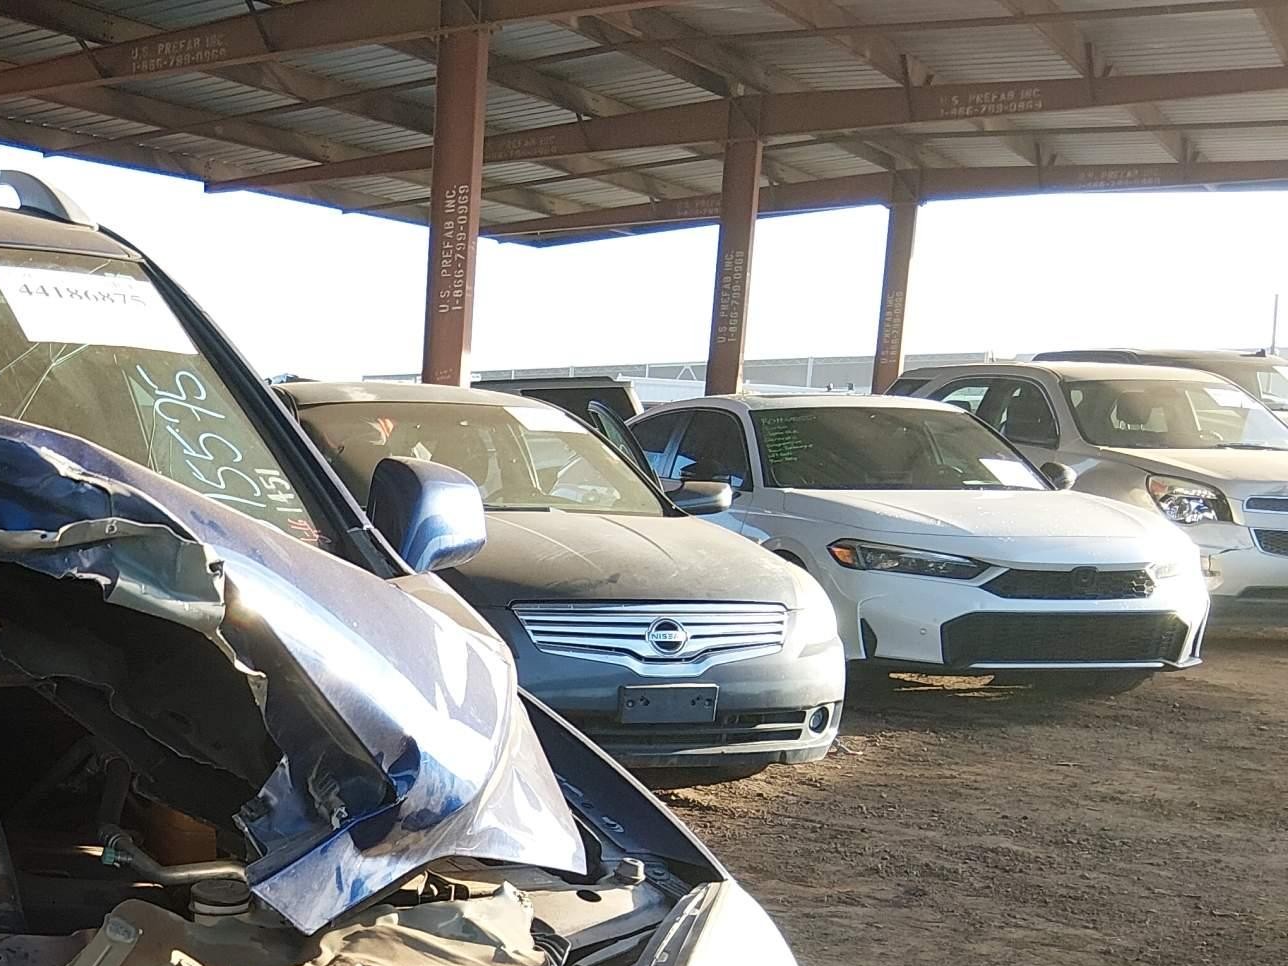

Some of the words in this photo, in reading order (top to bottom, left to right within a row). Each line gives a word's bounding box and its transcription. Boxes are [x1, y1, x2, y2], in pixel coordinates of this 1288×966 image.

[445, 184, 458, 214] INC.
[441, 221, 455, 277] PREFAB
[452, 184, 470, 310] 1-866-799-0969
[17, 282, 148, 308] 44186875
[438, 284, 451, 313] U.S.
[720, 275, 732, 317] PREFAB
